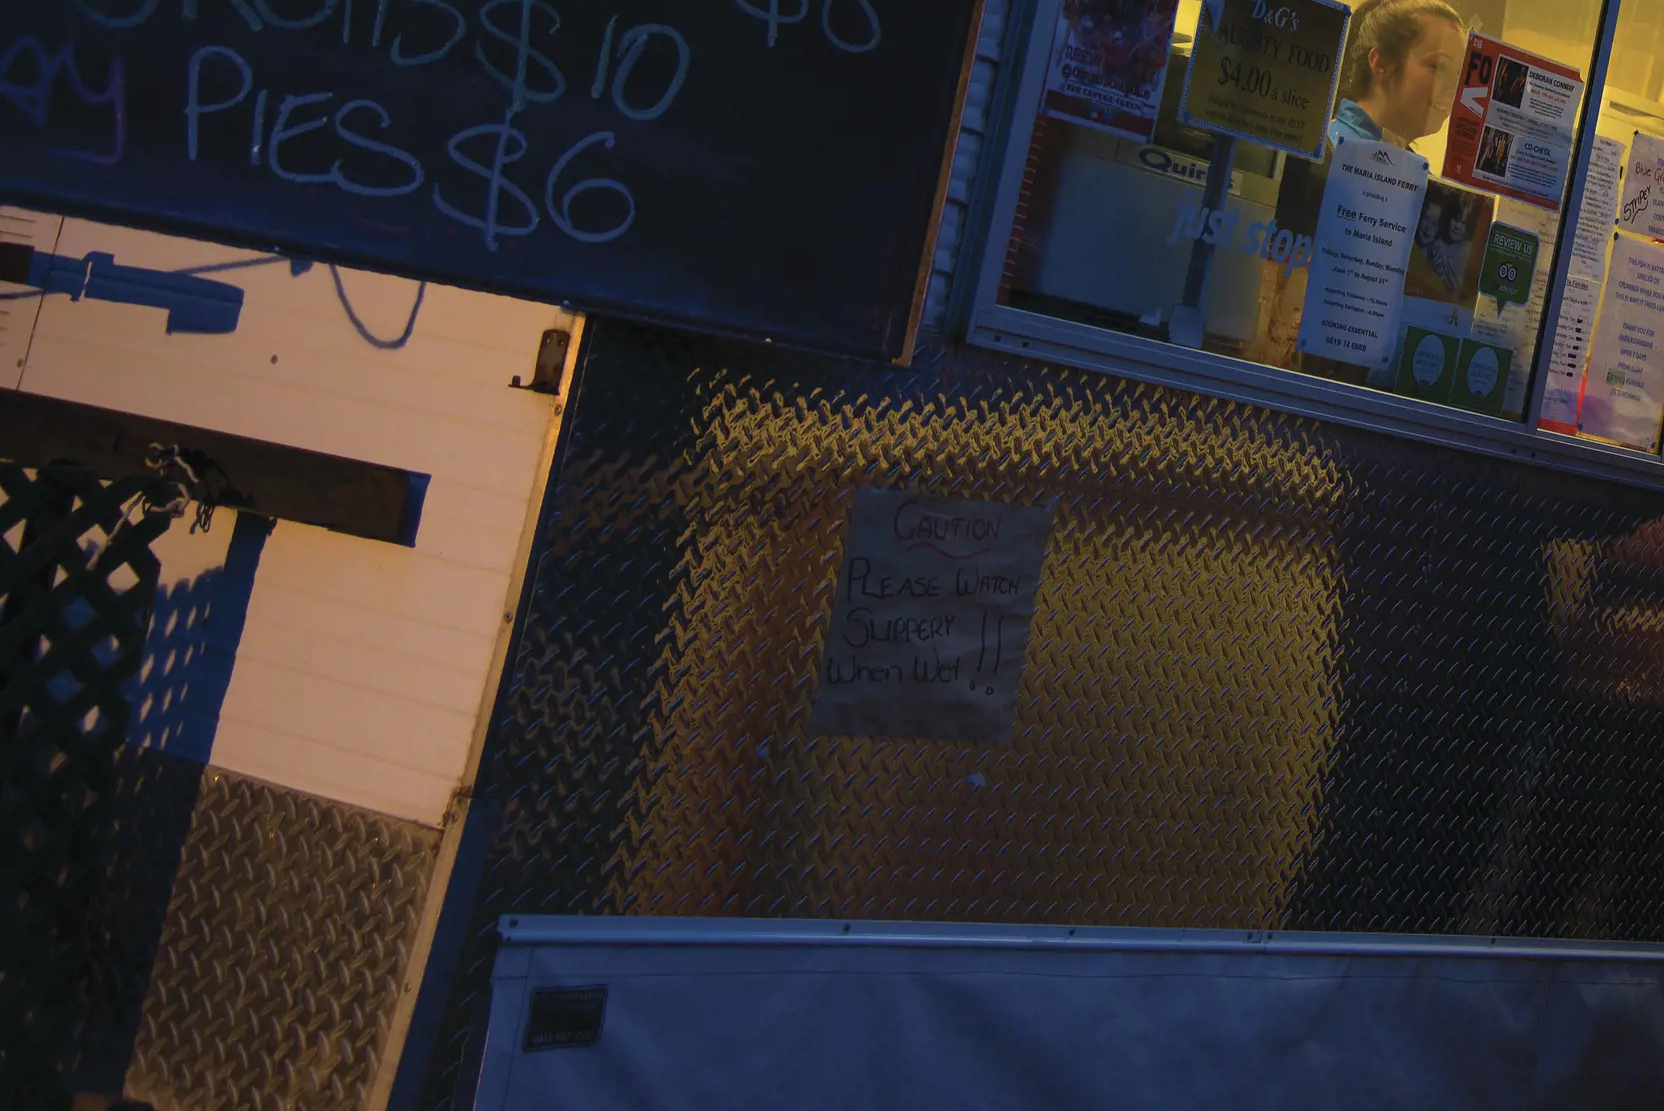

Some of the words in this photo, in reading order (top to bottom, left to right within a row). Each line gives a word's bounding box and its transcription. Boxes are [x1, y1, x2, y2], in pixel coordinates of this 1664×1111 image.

[1288, 44, 1330, 74] FOOD
[1217, 57, 1272, 99] $4.00
[1281, 89, 1310, 110] slice
[183, 44, 425, 197] PIES
[432, 111, 637, 253] $6
[1342, 164, 1354, 174] THE
[1353, 167, 1373, 180] MARIA
[1374, 172, 1397, 186] ISLAND
[1397, 180, 1419, 192] FERRY
[1635, 161, 1652, 177] Blue
[1337, 204, 1357, 219] Free
[1358, 212, 1378, 227] Ferry
[1379, 218, 1407, 233] Service
[1240, 218, 1313, 278] stop
[1345, 228, 1352, 236] to
[1353, 229, 1372, 241] Maria
[1372, 235, 1393, 247] Island
[1493, 233, 1523, 251] REVIEW
[1523, 242, 1534, 255] US
[1348, 326, 1378, 339] ESSENTIAL
[893, 499, 1001, 541] CAUTION
[846, 556, 941, 603] PLEASE
[955, 566, 1020, 597] WATCH
[842, 607, 957, 649] SLIPPERY
